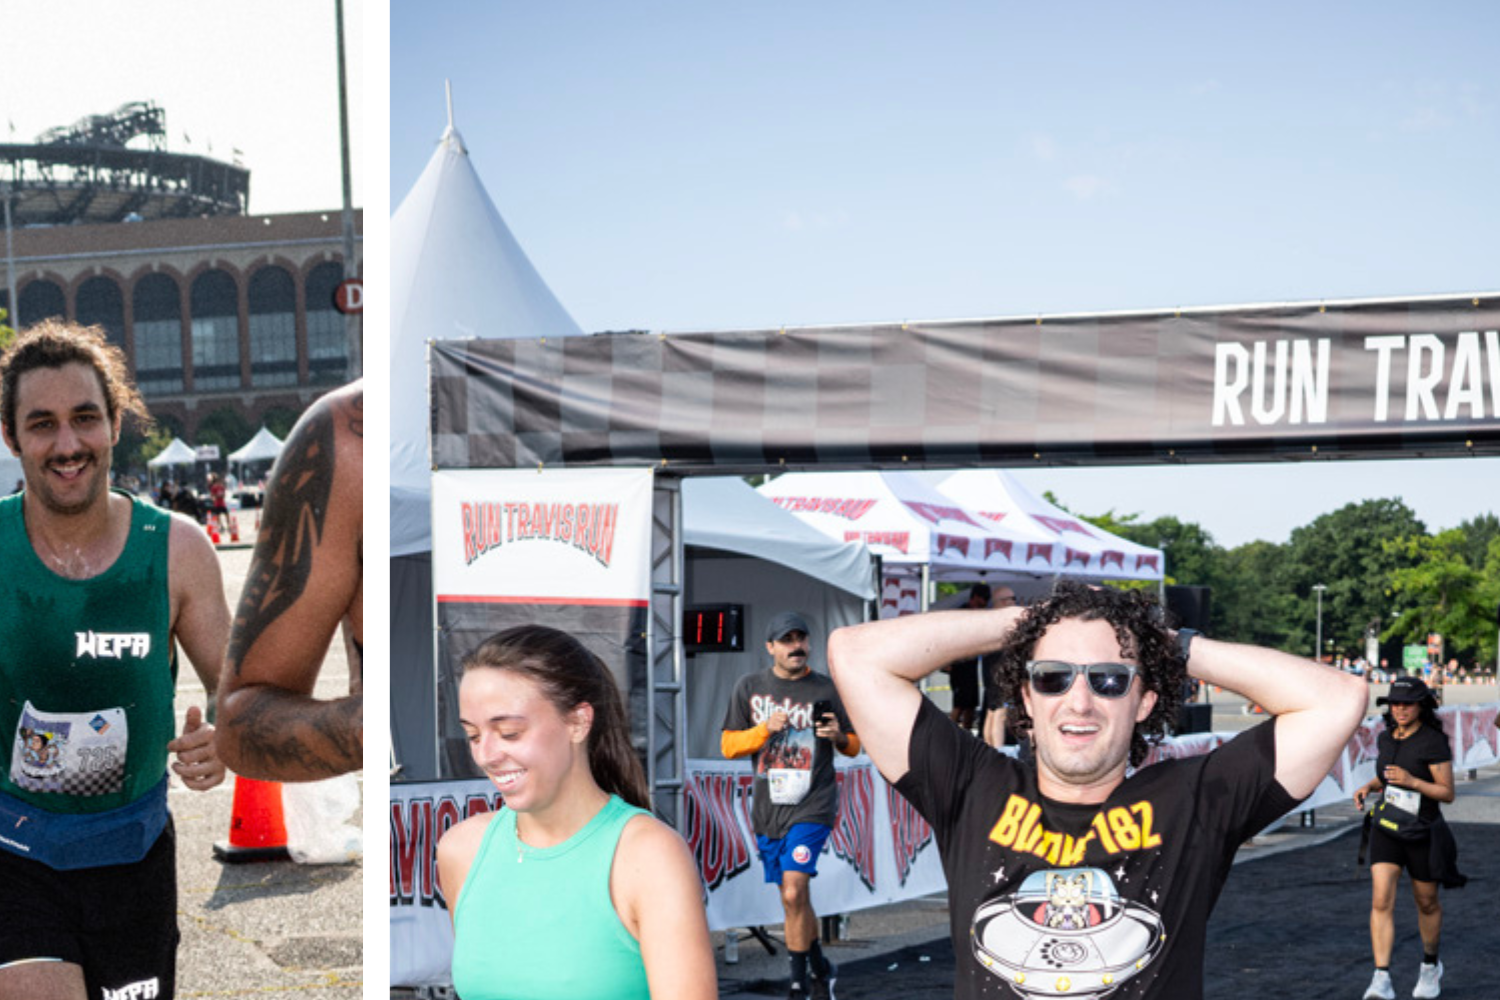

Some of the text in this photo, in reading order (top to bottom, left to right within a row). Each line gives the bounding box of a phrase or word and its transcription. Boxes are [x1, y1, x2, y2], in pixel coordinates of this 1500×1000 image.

[345, 283, 363, 309] D
[1211, 338, 1331, 426] RUN
[461, 502, 619, 568] RUN TRAVIS RUN
[1091, 800, 1163, 854] 182
